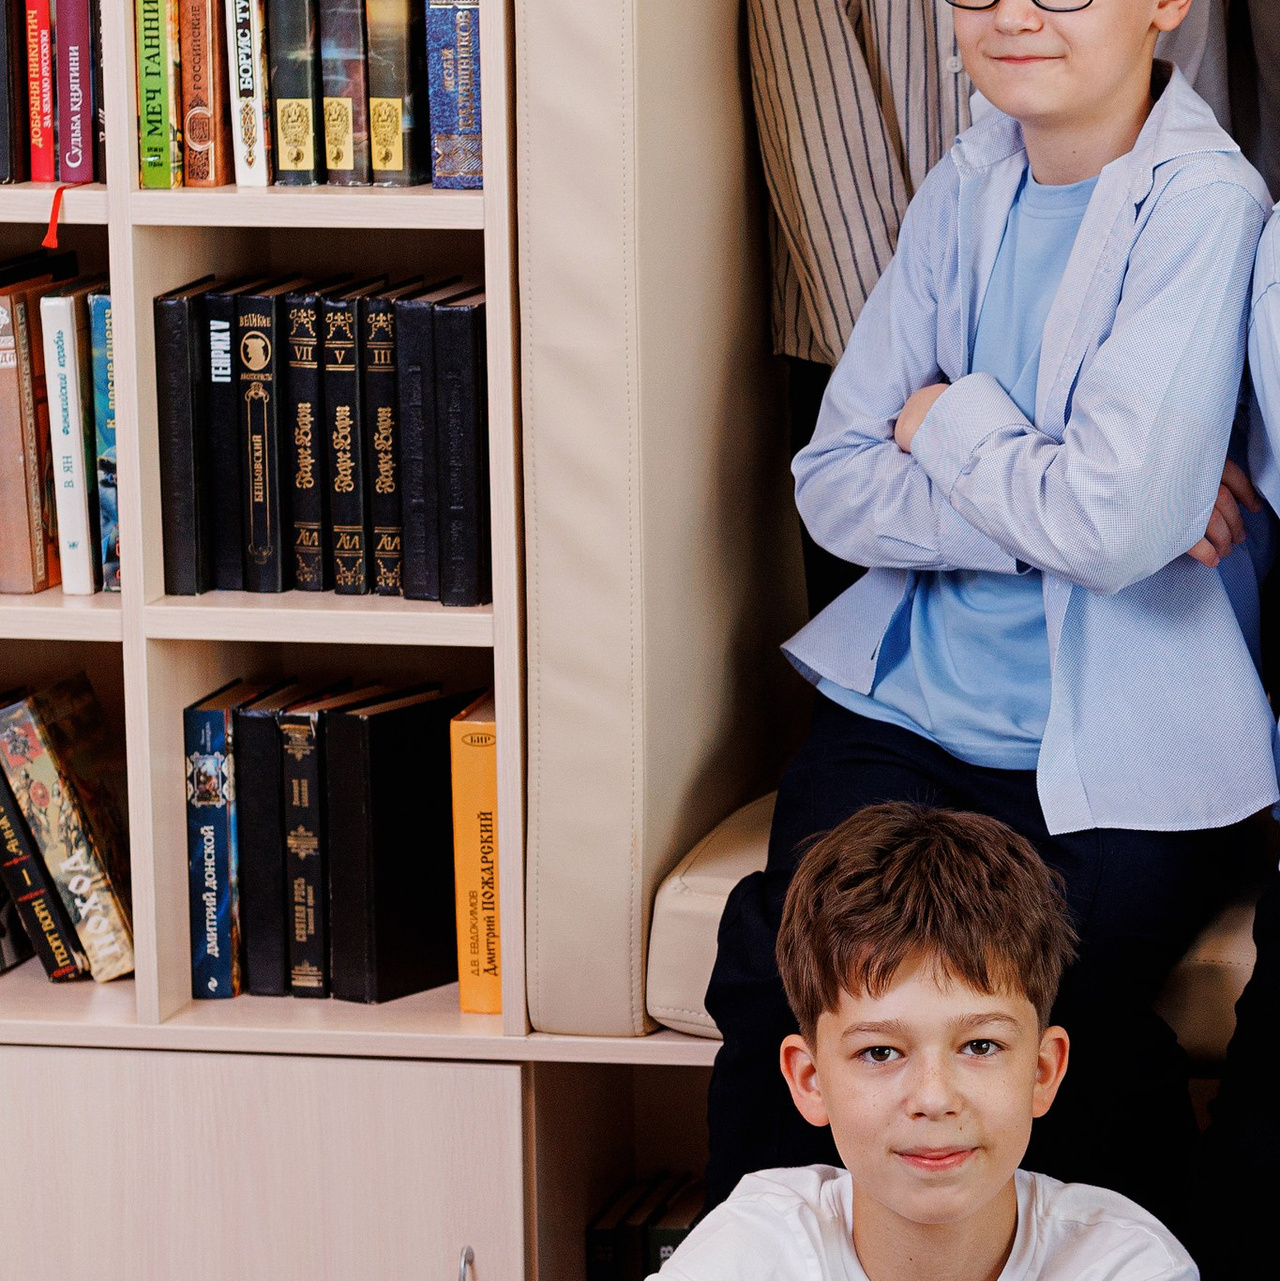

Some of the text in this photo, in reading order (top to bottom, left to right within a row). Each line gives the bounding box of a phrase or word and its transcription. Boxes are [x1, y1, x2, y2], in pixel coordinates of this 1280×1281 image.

[27, 9, 43, 149] ДОБРЫНЯ НИКИТИЧ
[188, 5, 201, 91] РОССИЙСКИЕ
[238, 29, 253, 91] БОРИС
[42, 115, 52, 128] ЗА
[146, 88, 163, 137] МЕЧ
[210, 331, 231, 382] ГЕНРИХ
[295, 345, 313, 361] VII
[334, 350, 345, 364] V
[374, 349, 392, 364] III
[57, 330, 74, 473] ЯН Финикийский корабль
[60, 849, 121, 956] ПОХОД
[200, 825, 219, 959] ДМИТРИЙ ДОНСКОЙ
[477, 810, 499, 976] Дмитрий ПОЖАРСКИЙ
